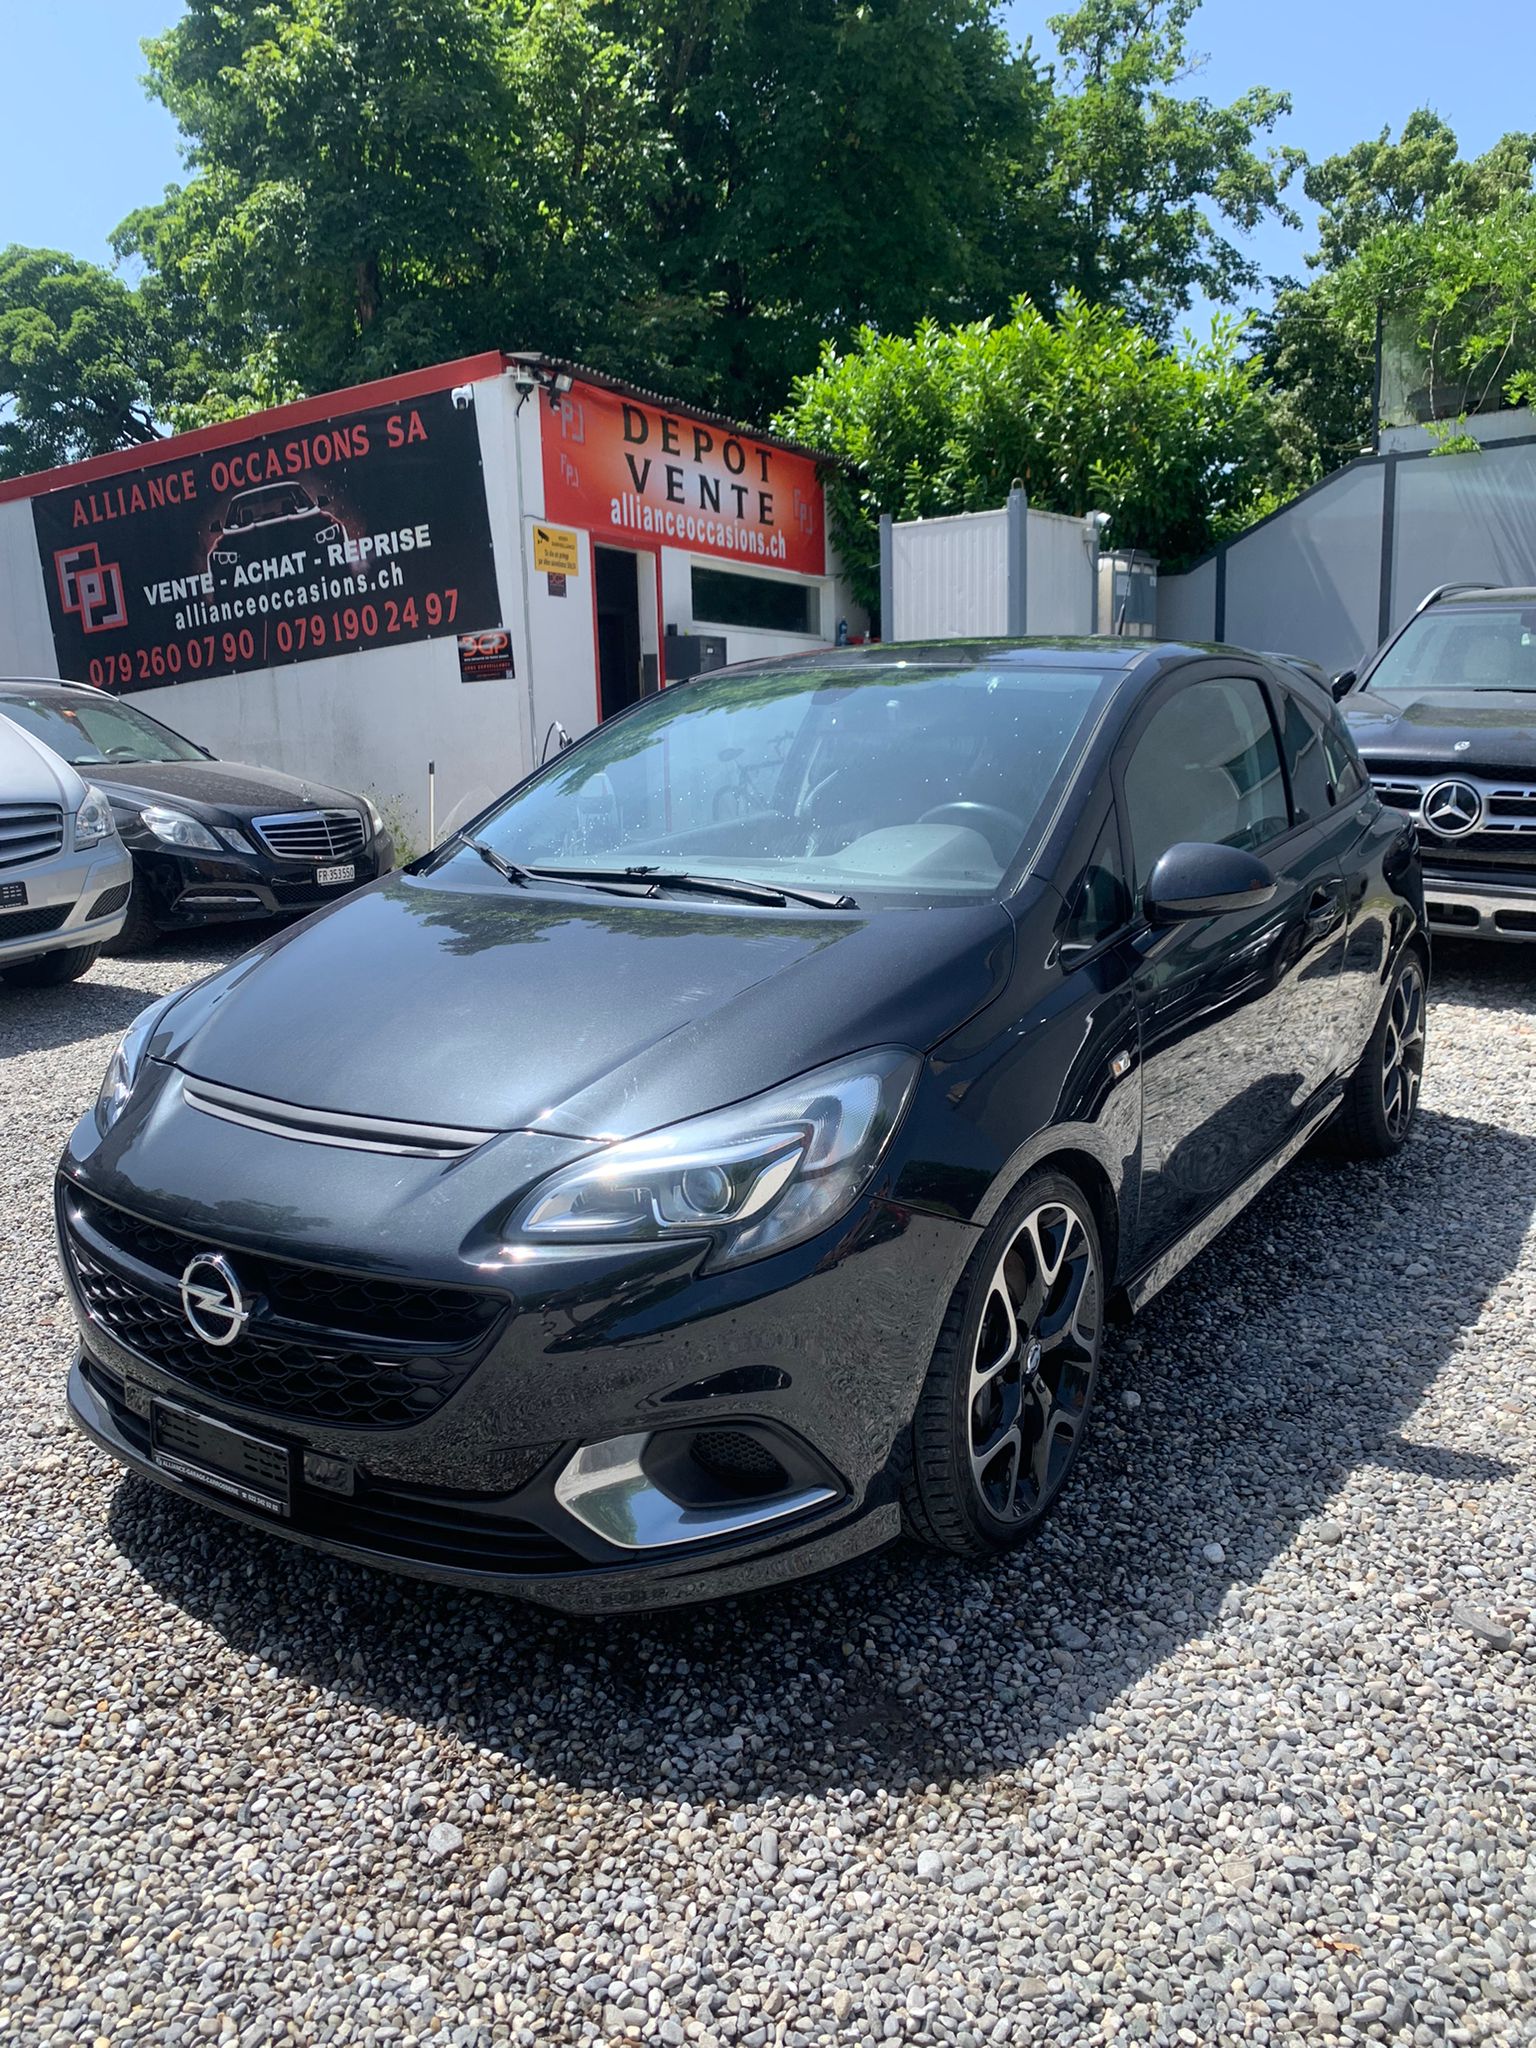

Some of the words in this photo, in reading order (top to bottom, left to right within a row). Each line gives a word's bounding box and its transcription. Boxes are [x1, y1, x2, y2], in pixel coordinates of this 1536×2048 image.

[72, 469, 197, 528] ALLIANCE
[211, 424, 370, 492] OCCASIONS
[386, 410, 428, 448] SA
[624, 452, 774, 526] VENTE
[610, 492, 786, 559] allianceoccasions.ch
[143, 573, 214, 606] VENTE
[233, 551, 307, 587] ACHAT
[327, 524, 432, 567] REPRISE
[175, 561, 404, 630] allianceoccasions.ch
[89, 653, 132, 687] 079
[136, 643, 182, 679] 260
[187, 636, 215, 669] 07
[222, 629, 254, 663] 90
[277, 615, 326, 652] 079
[332, 604, 378, 642] 190
[384, 597, 420, 633] 24
[425, 588, 458, 626] 97
